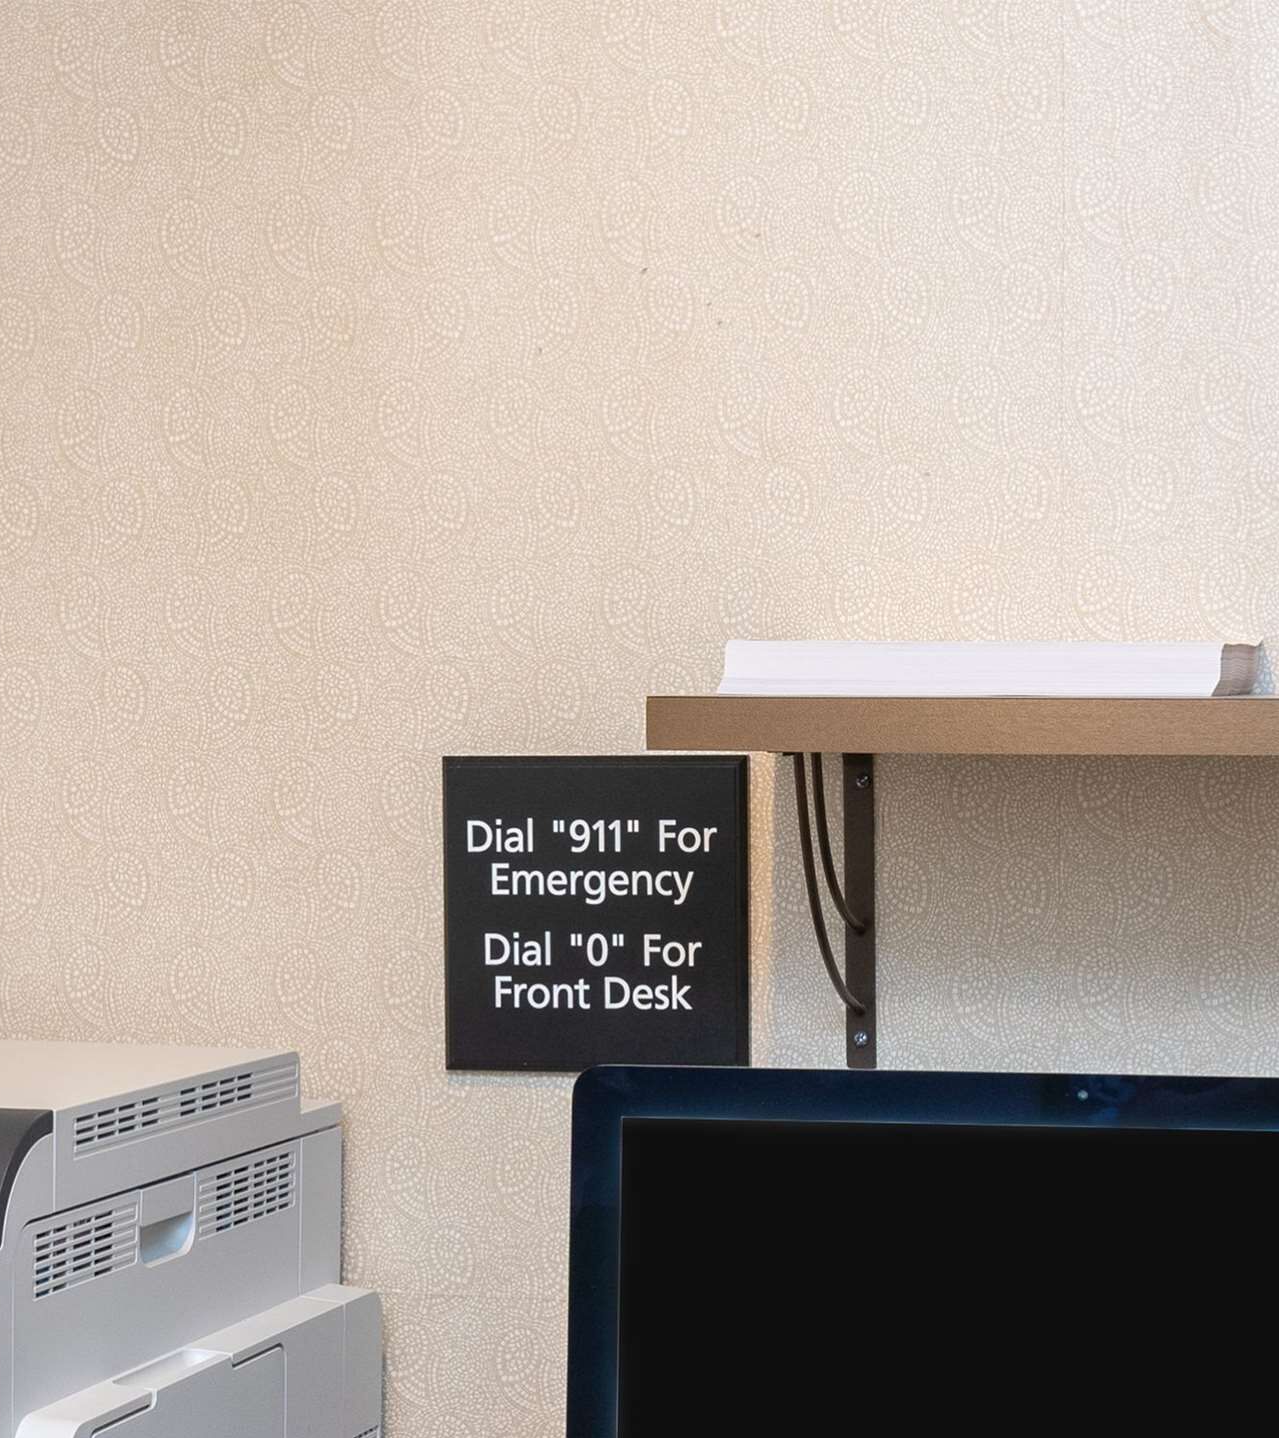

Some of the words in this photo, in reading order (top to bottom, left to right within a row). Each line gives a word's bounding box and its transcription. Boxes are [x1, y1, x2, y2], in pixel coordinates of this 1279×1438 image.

[466, 817, 534, 853] Dial
[552, 819, 640, 853] "911"
[658, 819, 718, 853] For
[490, 862, 694, 905] Emergency
[483, 931, 552, 967] Dial
[570, 933, 625, 967] "0"
[643, 933, 703, 967] For
[494, 975, 591, 1009] Front
[603, 974, 693, 1011] Desk
